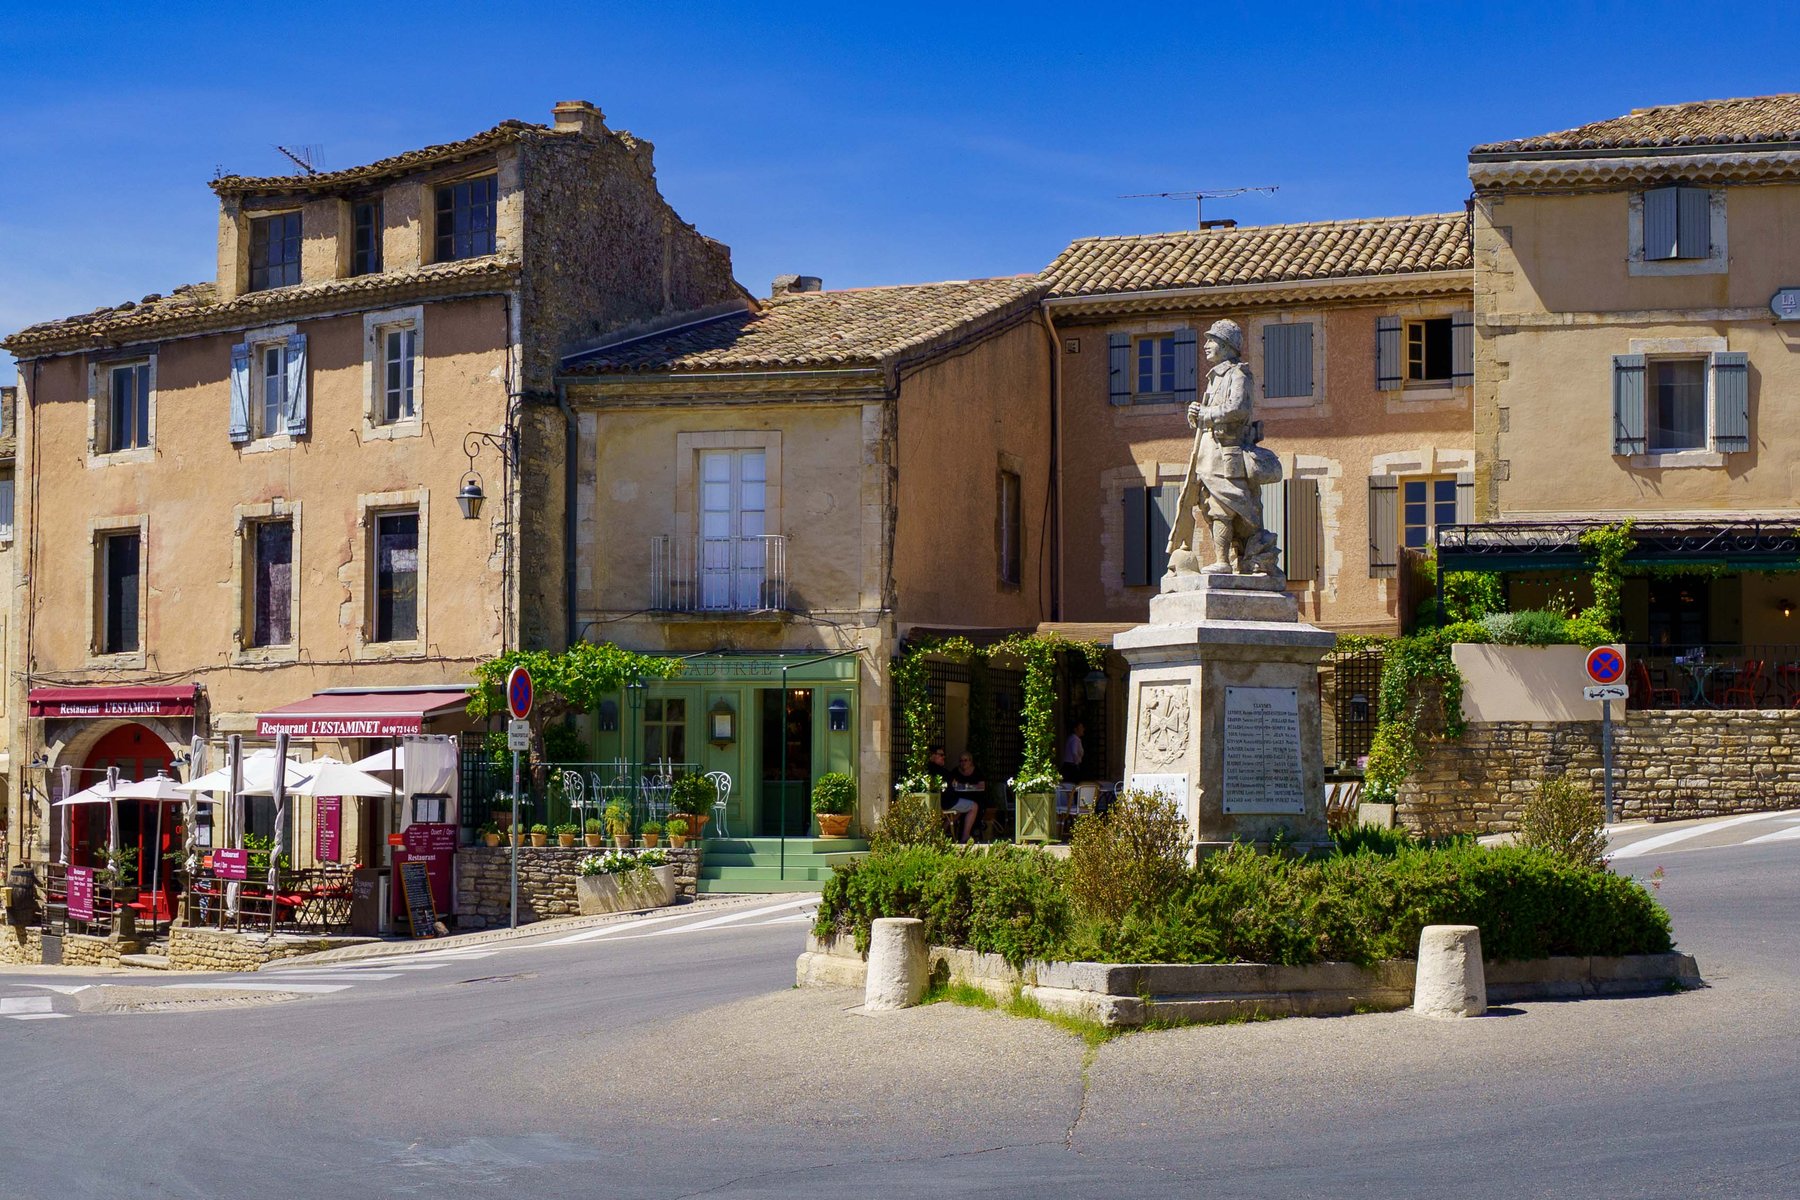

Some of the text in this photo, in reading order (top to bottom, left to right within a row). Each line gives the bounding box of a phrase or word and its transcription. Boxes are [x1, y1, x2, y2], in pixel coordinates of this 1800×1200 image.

[60, 701, 161, 714] Restaurant L'ESTAMINET
[260, 721, 308, 734] Restaurant
[311, 720, 380, 734] L'ESTAMINET
